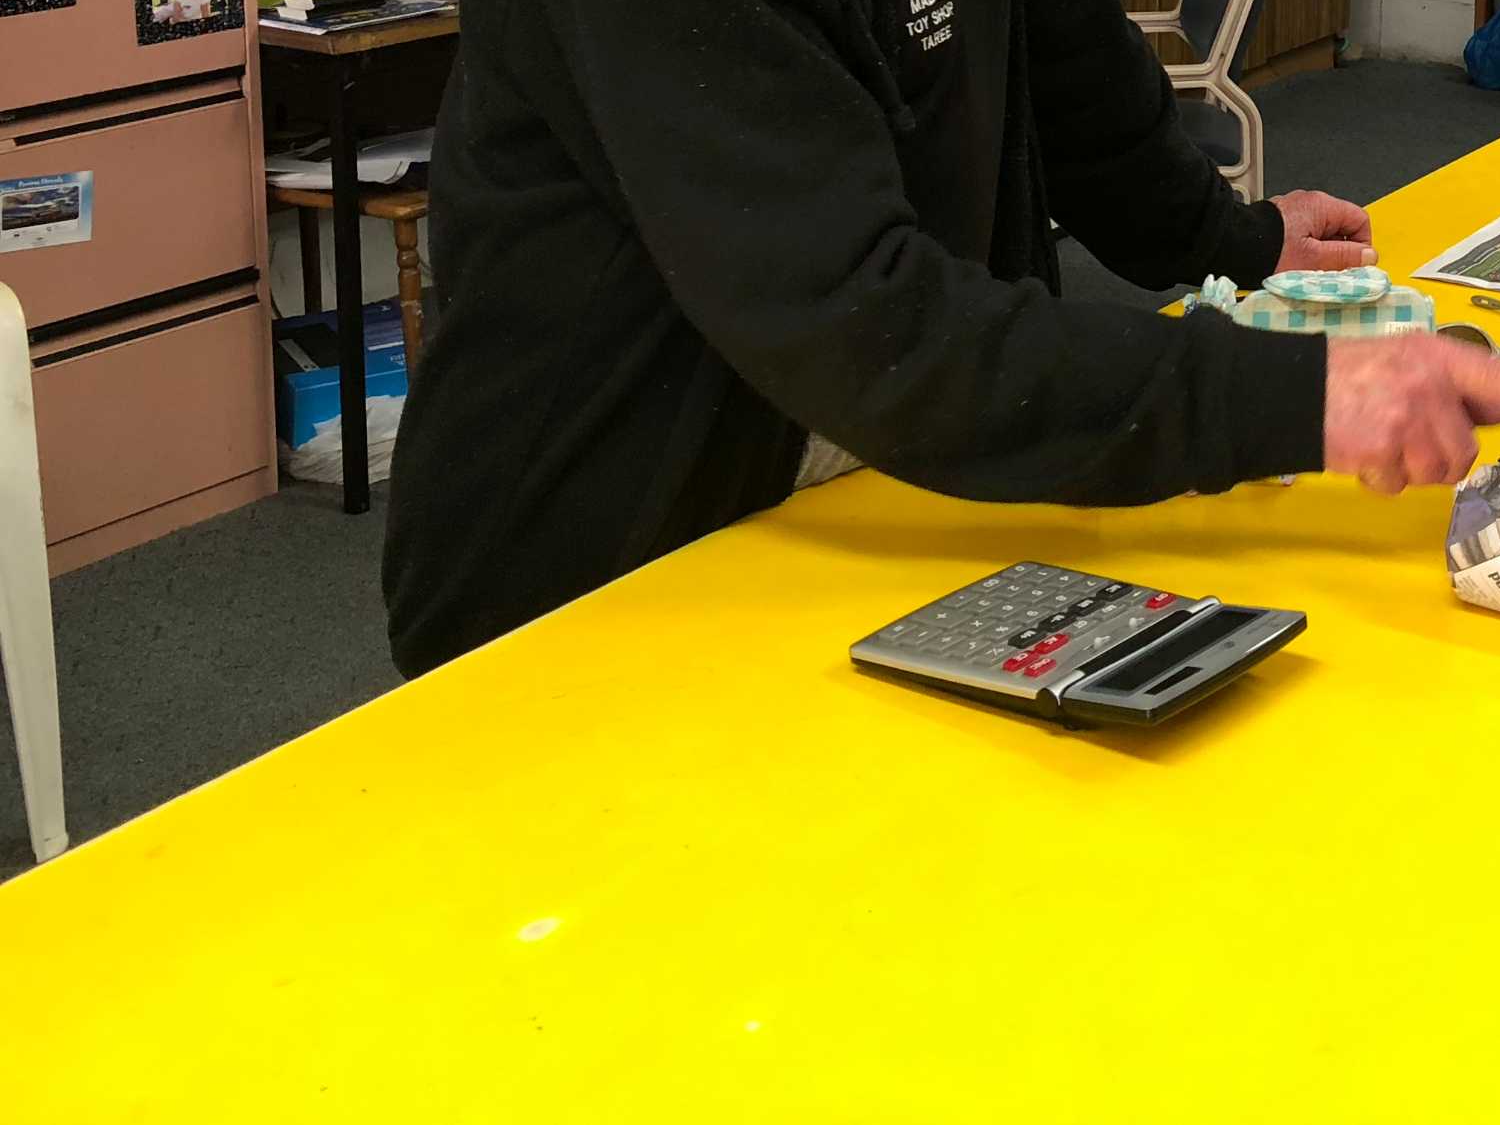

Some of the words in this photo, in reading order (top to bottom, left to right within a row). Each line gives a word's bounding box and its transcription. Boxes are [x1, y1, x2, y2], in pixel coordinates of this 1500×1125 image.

[906, 16, 929, 36] TOY
[931, 1, 954, 25] SHOP
[921, 24, 953, 51] TAREE
